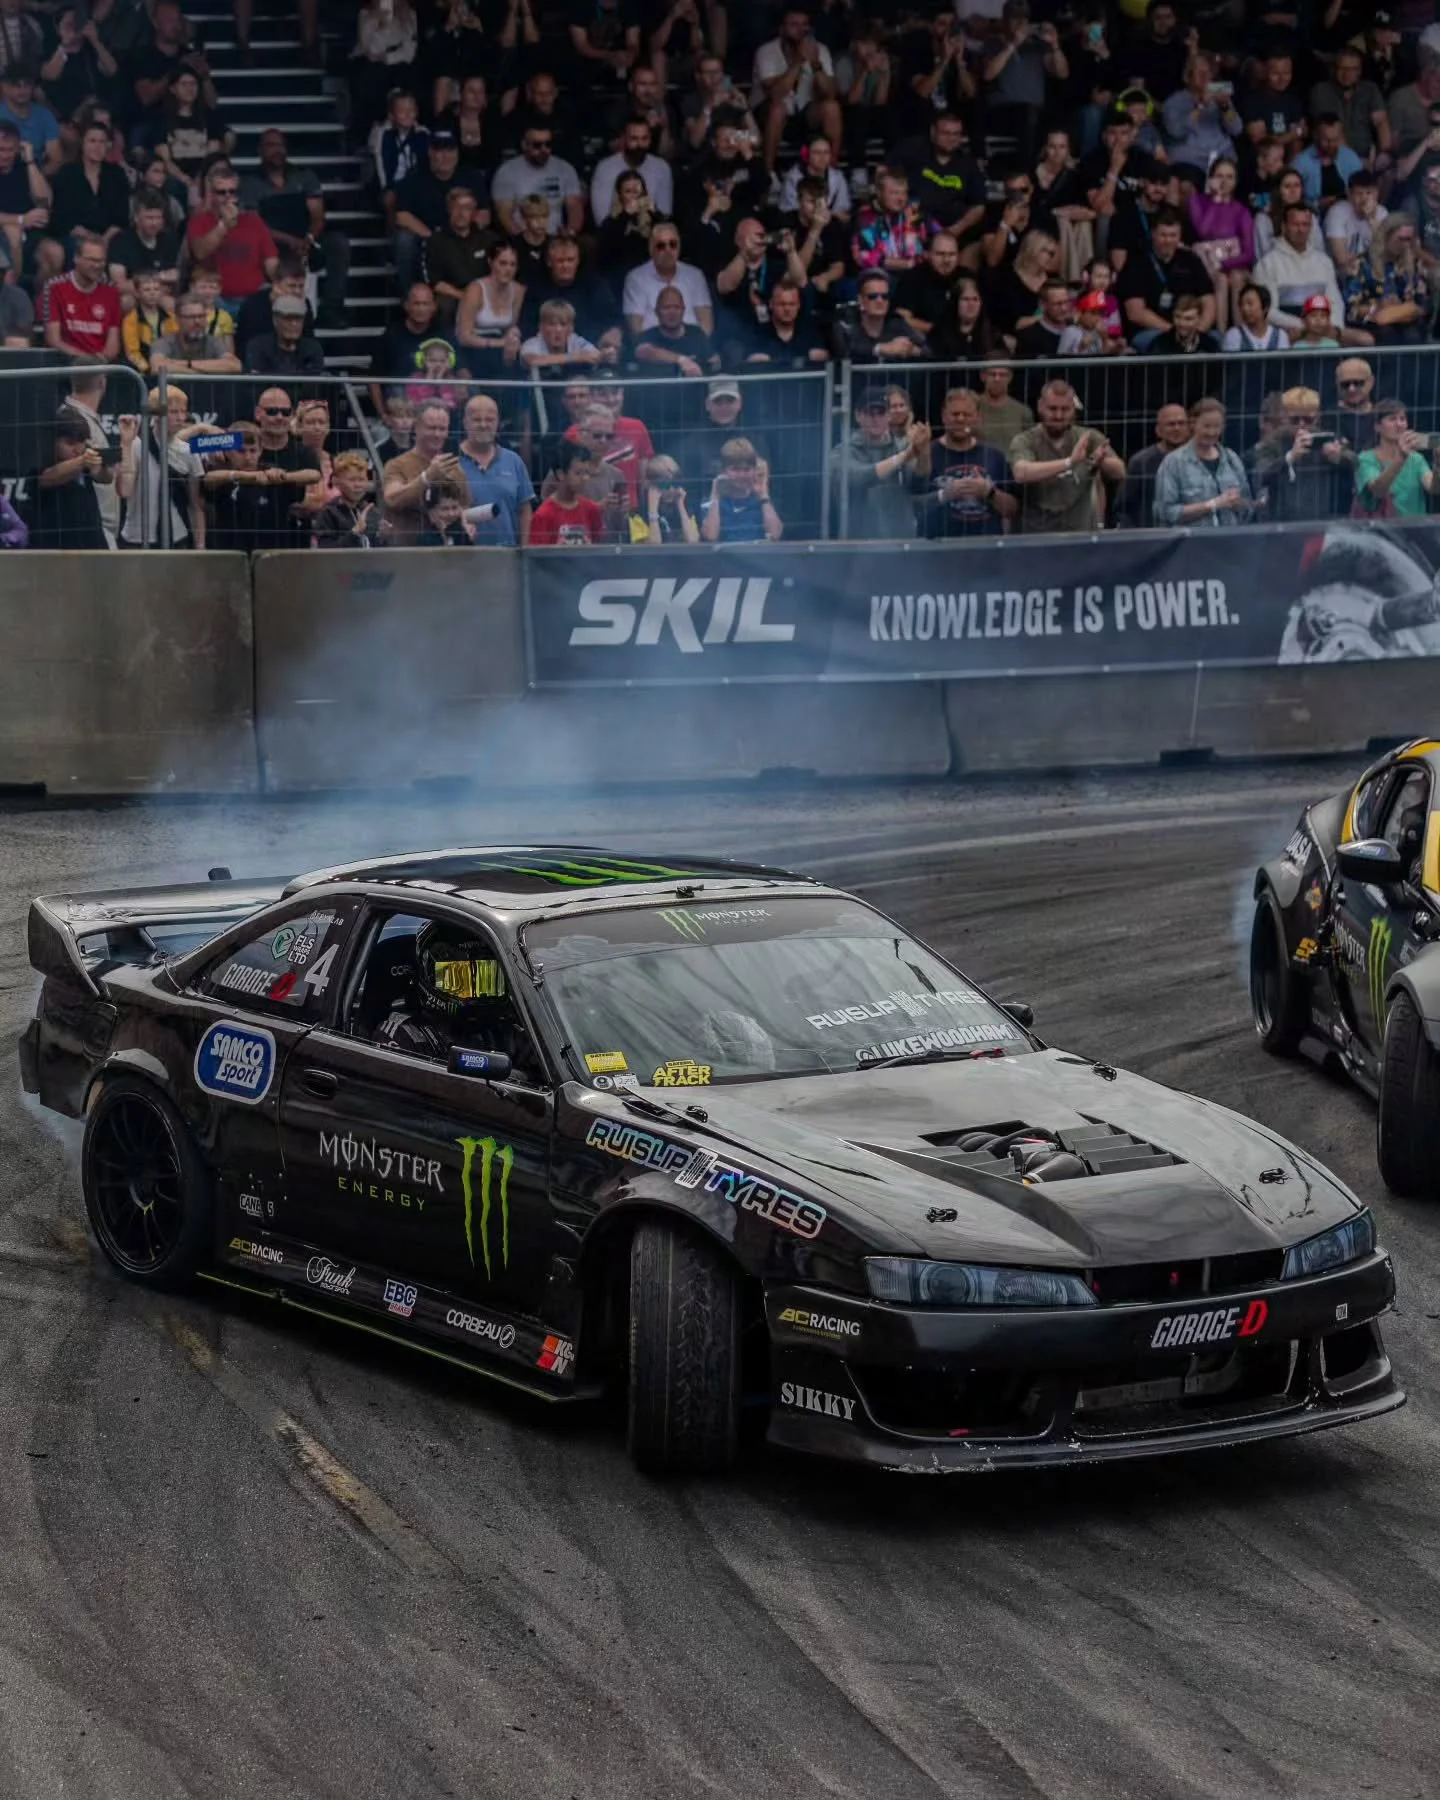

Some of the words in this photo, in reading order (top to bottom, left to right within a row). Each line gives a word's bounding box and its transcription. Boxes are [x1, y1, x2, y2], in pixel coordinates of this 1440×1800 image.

[568, 577, 796, 653] SKIL
[869, 588, 1063, 641] KNOWLEDGE
[1073, 585, 1104, 634] IS
[1113, 579, 1240, 632] POWER.
[694, 908, 771, 921] MONSTER
[287, 951, 307, 965] LTD
[304, 943, 340, 996] 4
[805, 1000, 899, 1031] RUISLIP
[913, 990, 988, 1008] TYRES
[210, 1032, 264, 1067] SAMCO
[221, 1063, 257, 1084] sport
[653, 1065, 711, 1078] AFTER
[653, 1075, 711, 1087] TRACK
[319, 1131, 446, 1193] MONSTER
[585, 1117, 695, 1174] RUISLIP
[703, 1160, 828, 1240] TYRES
[338, 1176, 425, 1211] ENERGY
[251, 1242, 284, 1263] RACING
[306, 1256, 356, 1288] Funk
[384, 1278, 418, 1308] EBC
[446, 1308, 501, 1341] CORBEAU
[809, 1313, 861, 1336] RACING
[781, 1382, 857, 1420] SIKKY
